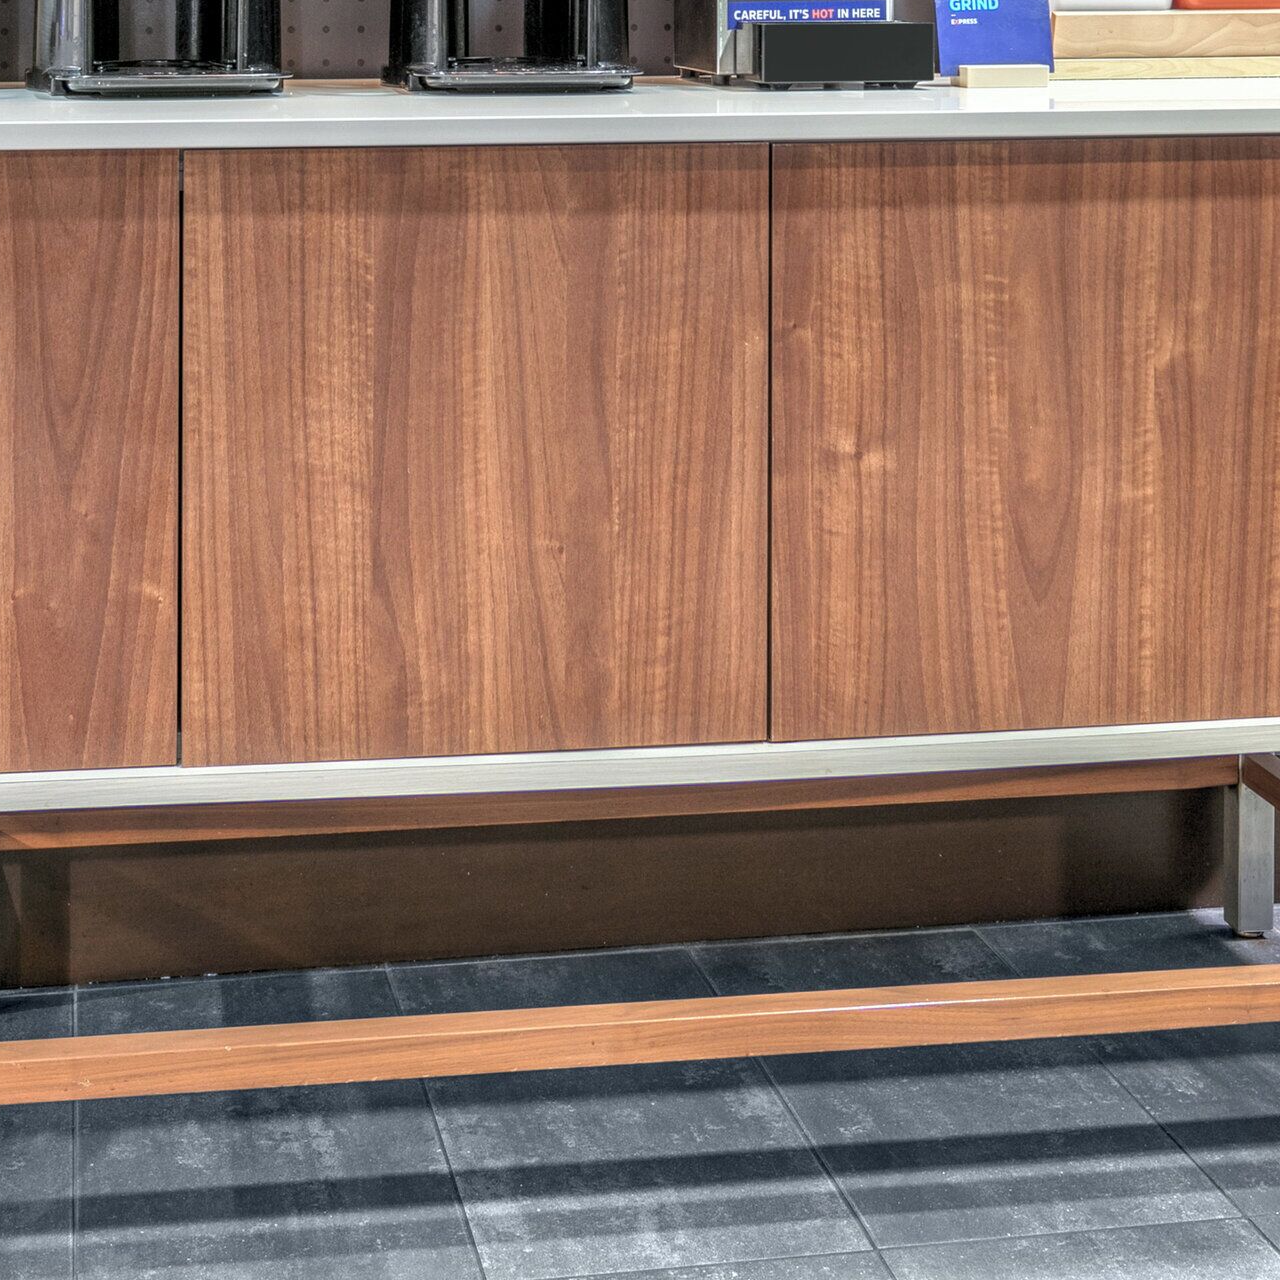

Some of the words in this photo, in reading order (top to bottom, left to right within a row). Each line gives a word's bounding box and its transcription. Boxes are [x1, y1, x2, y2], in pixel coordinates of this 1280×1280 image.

[733, 9, 786, 21] CAREFUL,
[789, 9, 809, 20] IT'S
[812, 8, 834, 19] HOT
[837, 8, 849, 19] IN
[852, 8, 881, 18] HERE
